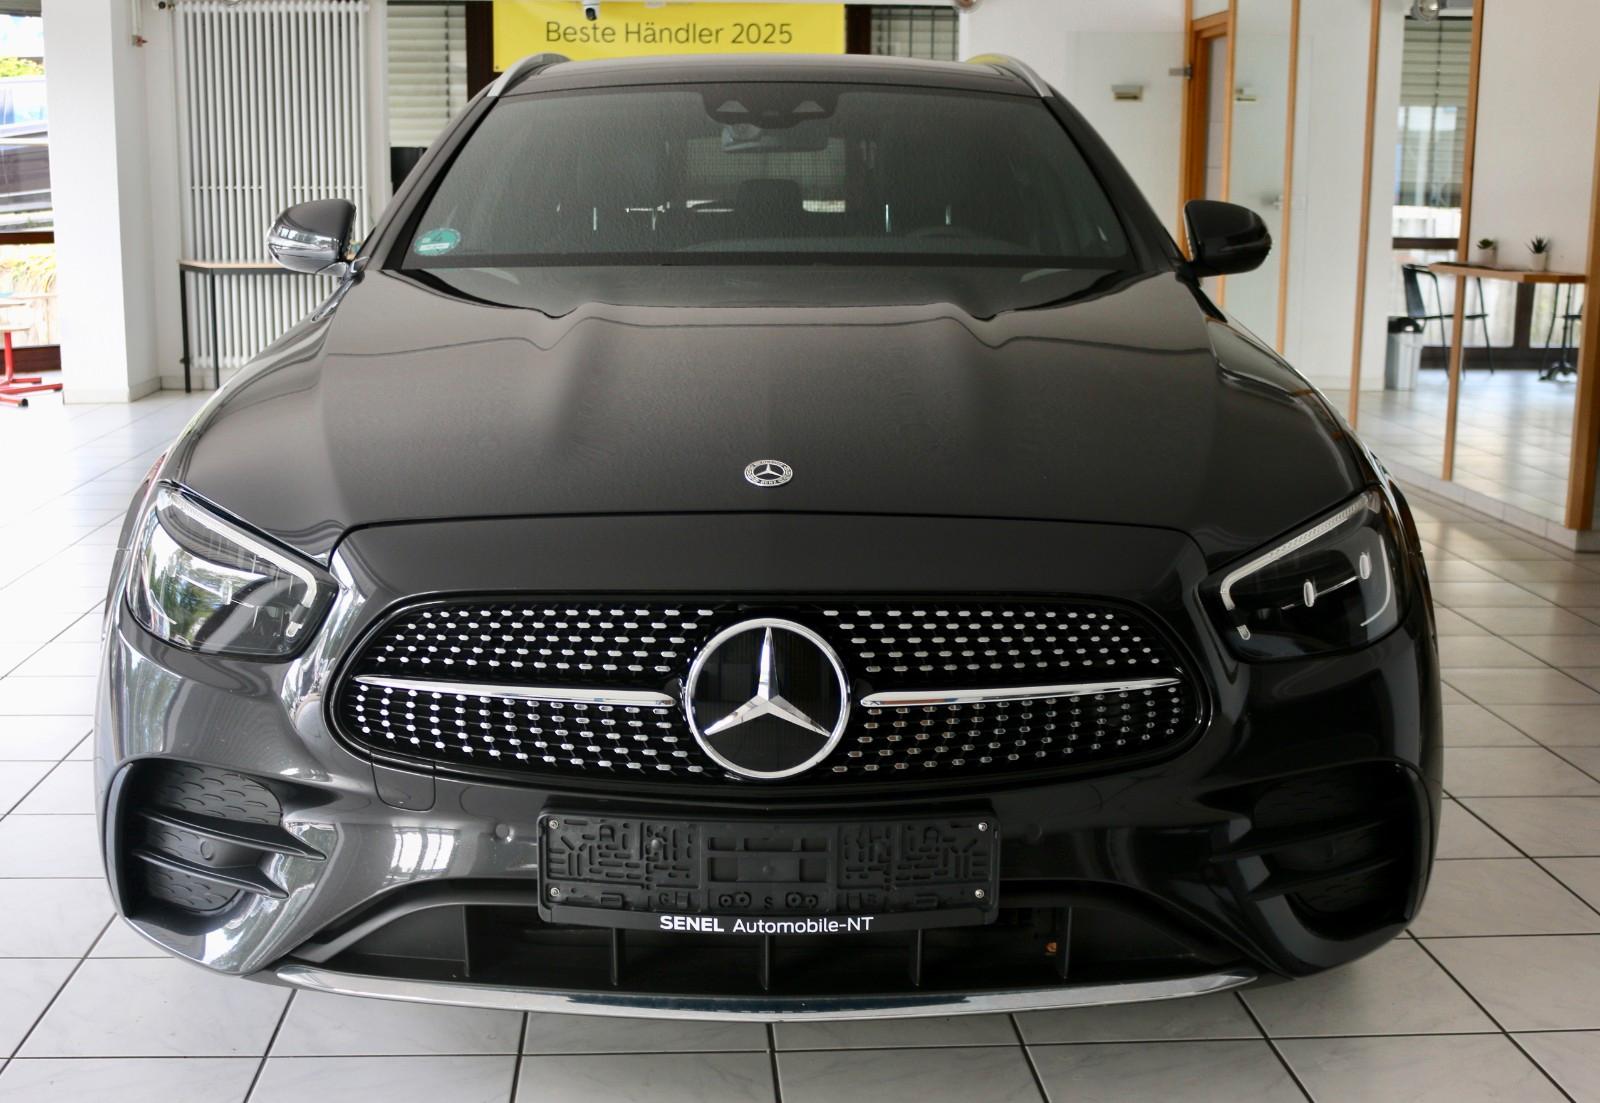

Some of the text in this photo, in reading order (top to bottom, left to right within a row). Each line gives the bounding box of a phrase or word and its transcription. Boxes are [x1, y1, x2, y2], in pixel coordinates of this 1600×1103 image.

[546, 21, 793, 44] Beste Händler 2025
[660, 916, 875, 933] SENEL Automobile-NT
